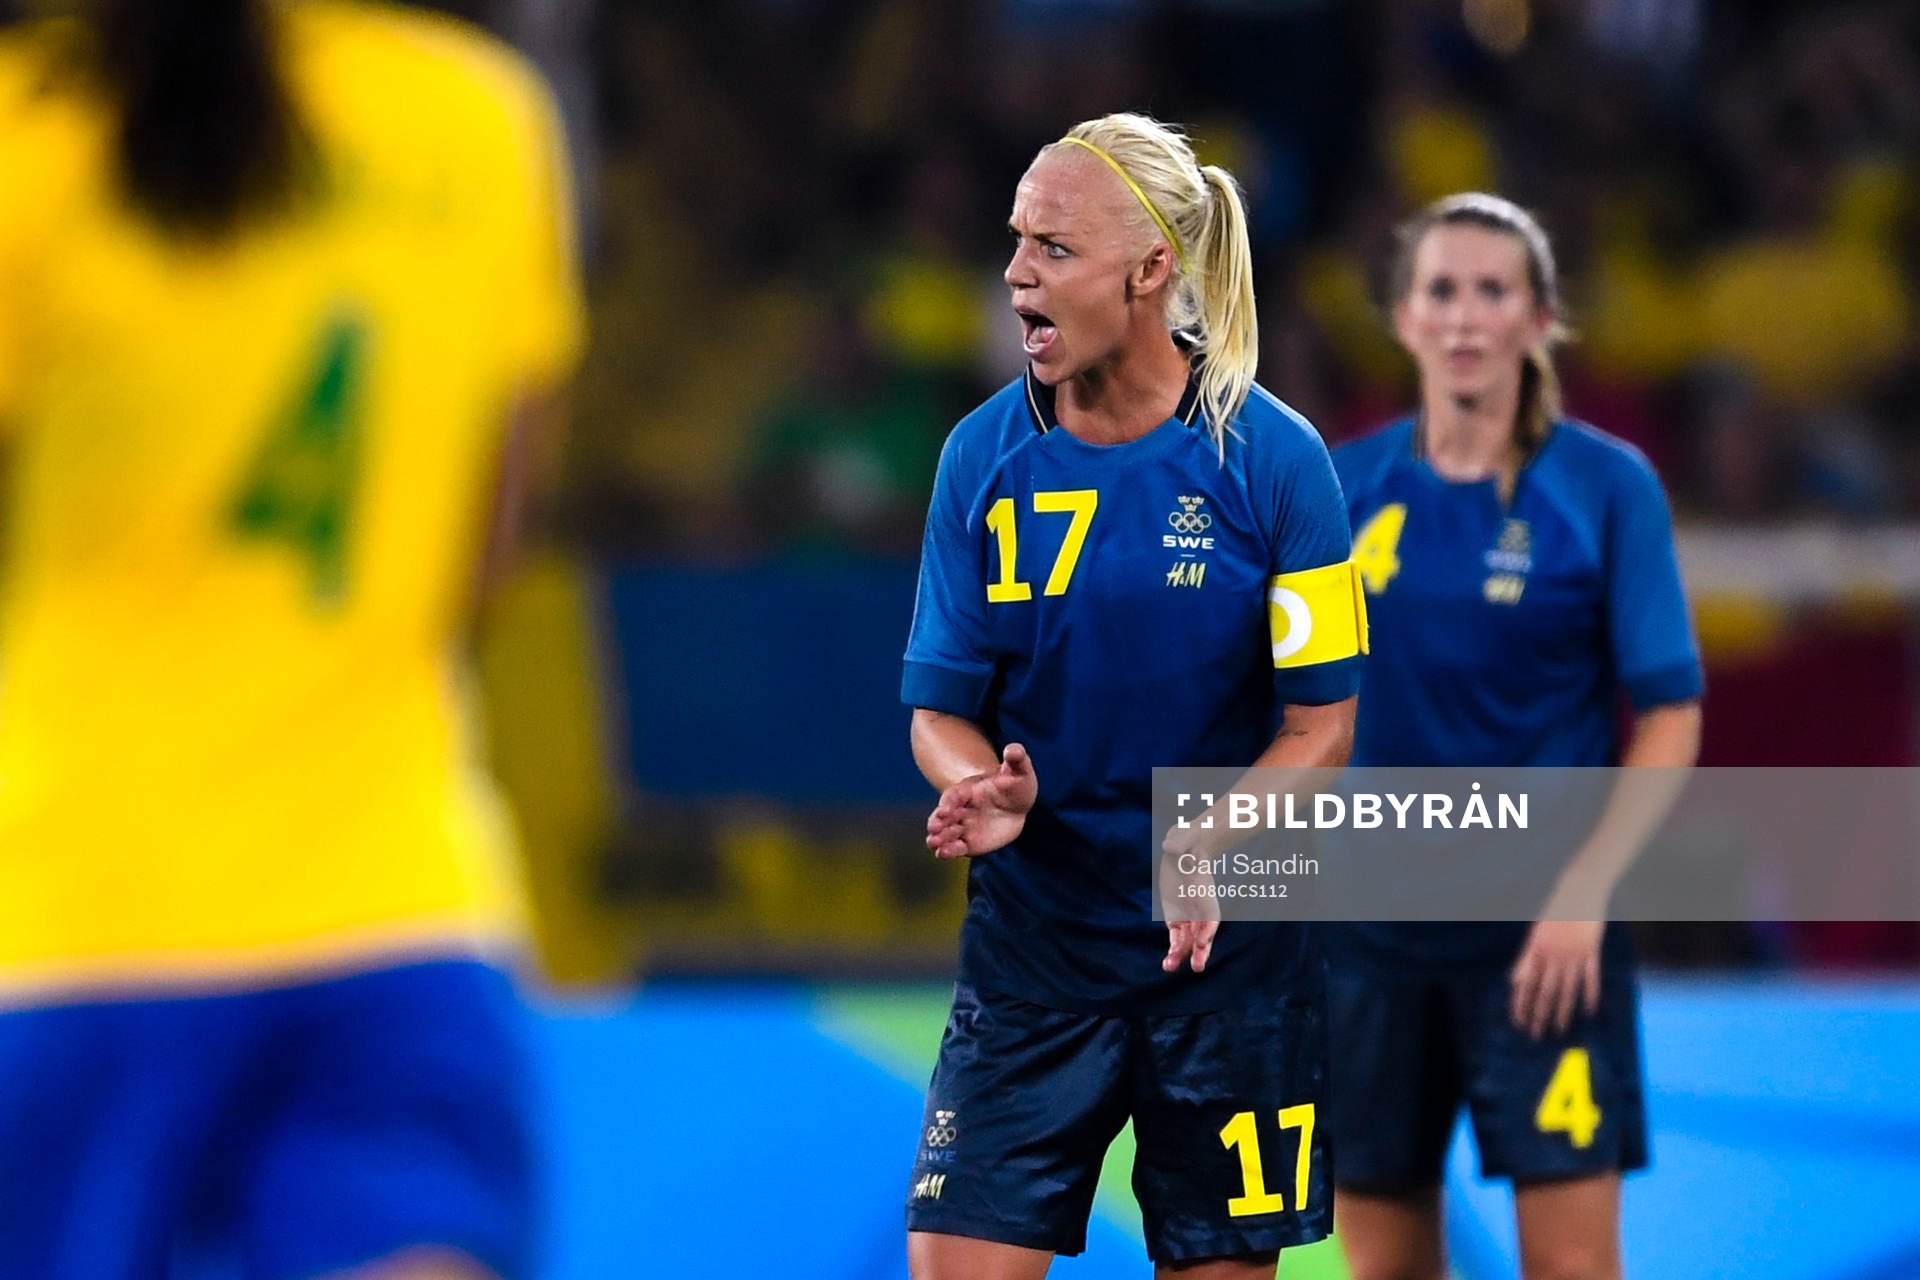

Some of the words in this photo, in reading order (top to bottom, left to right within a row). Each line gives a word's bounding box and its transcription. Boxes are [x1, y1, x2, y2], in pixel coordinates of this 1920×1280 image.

[228, 308, 370, 612] 4
[986, 490, 1098, 603] 17
[1162, 534, 1215, 550] SWE
[1351, 502, 1407, 594] 4
[1535, 1047, 1601, 1148] 4
[1219, 1103, 1316, 1218] 17
